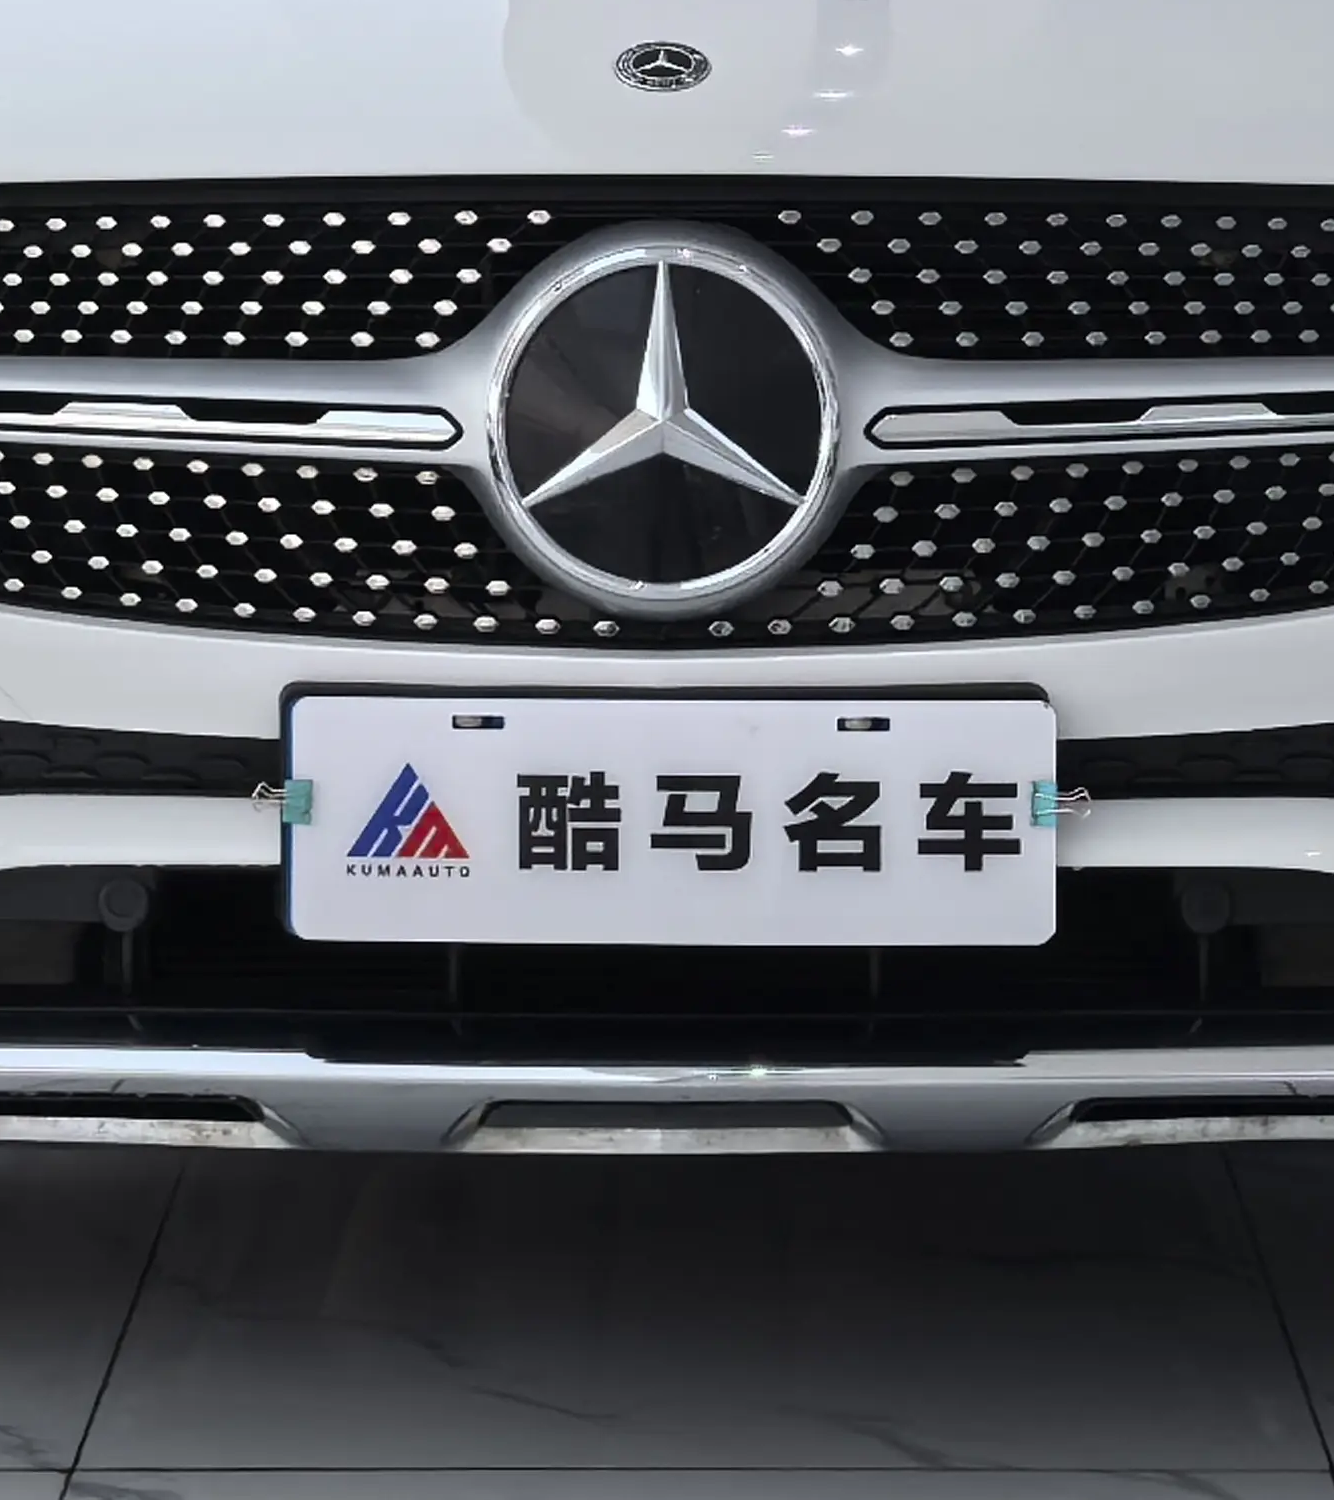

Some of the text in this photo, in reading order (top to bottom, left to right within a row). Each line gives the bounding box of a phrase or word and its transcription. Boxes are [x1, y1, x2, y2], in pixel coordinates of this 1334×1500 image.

[517, 771, 1021, 872] 酷马名车
[346, 864, 470, 878] KUMAAUTO
